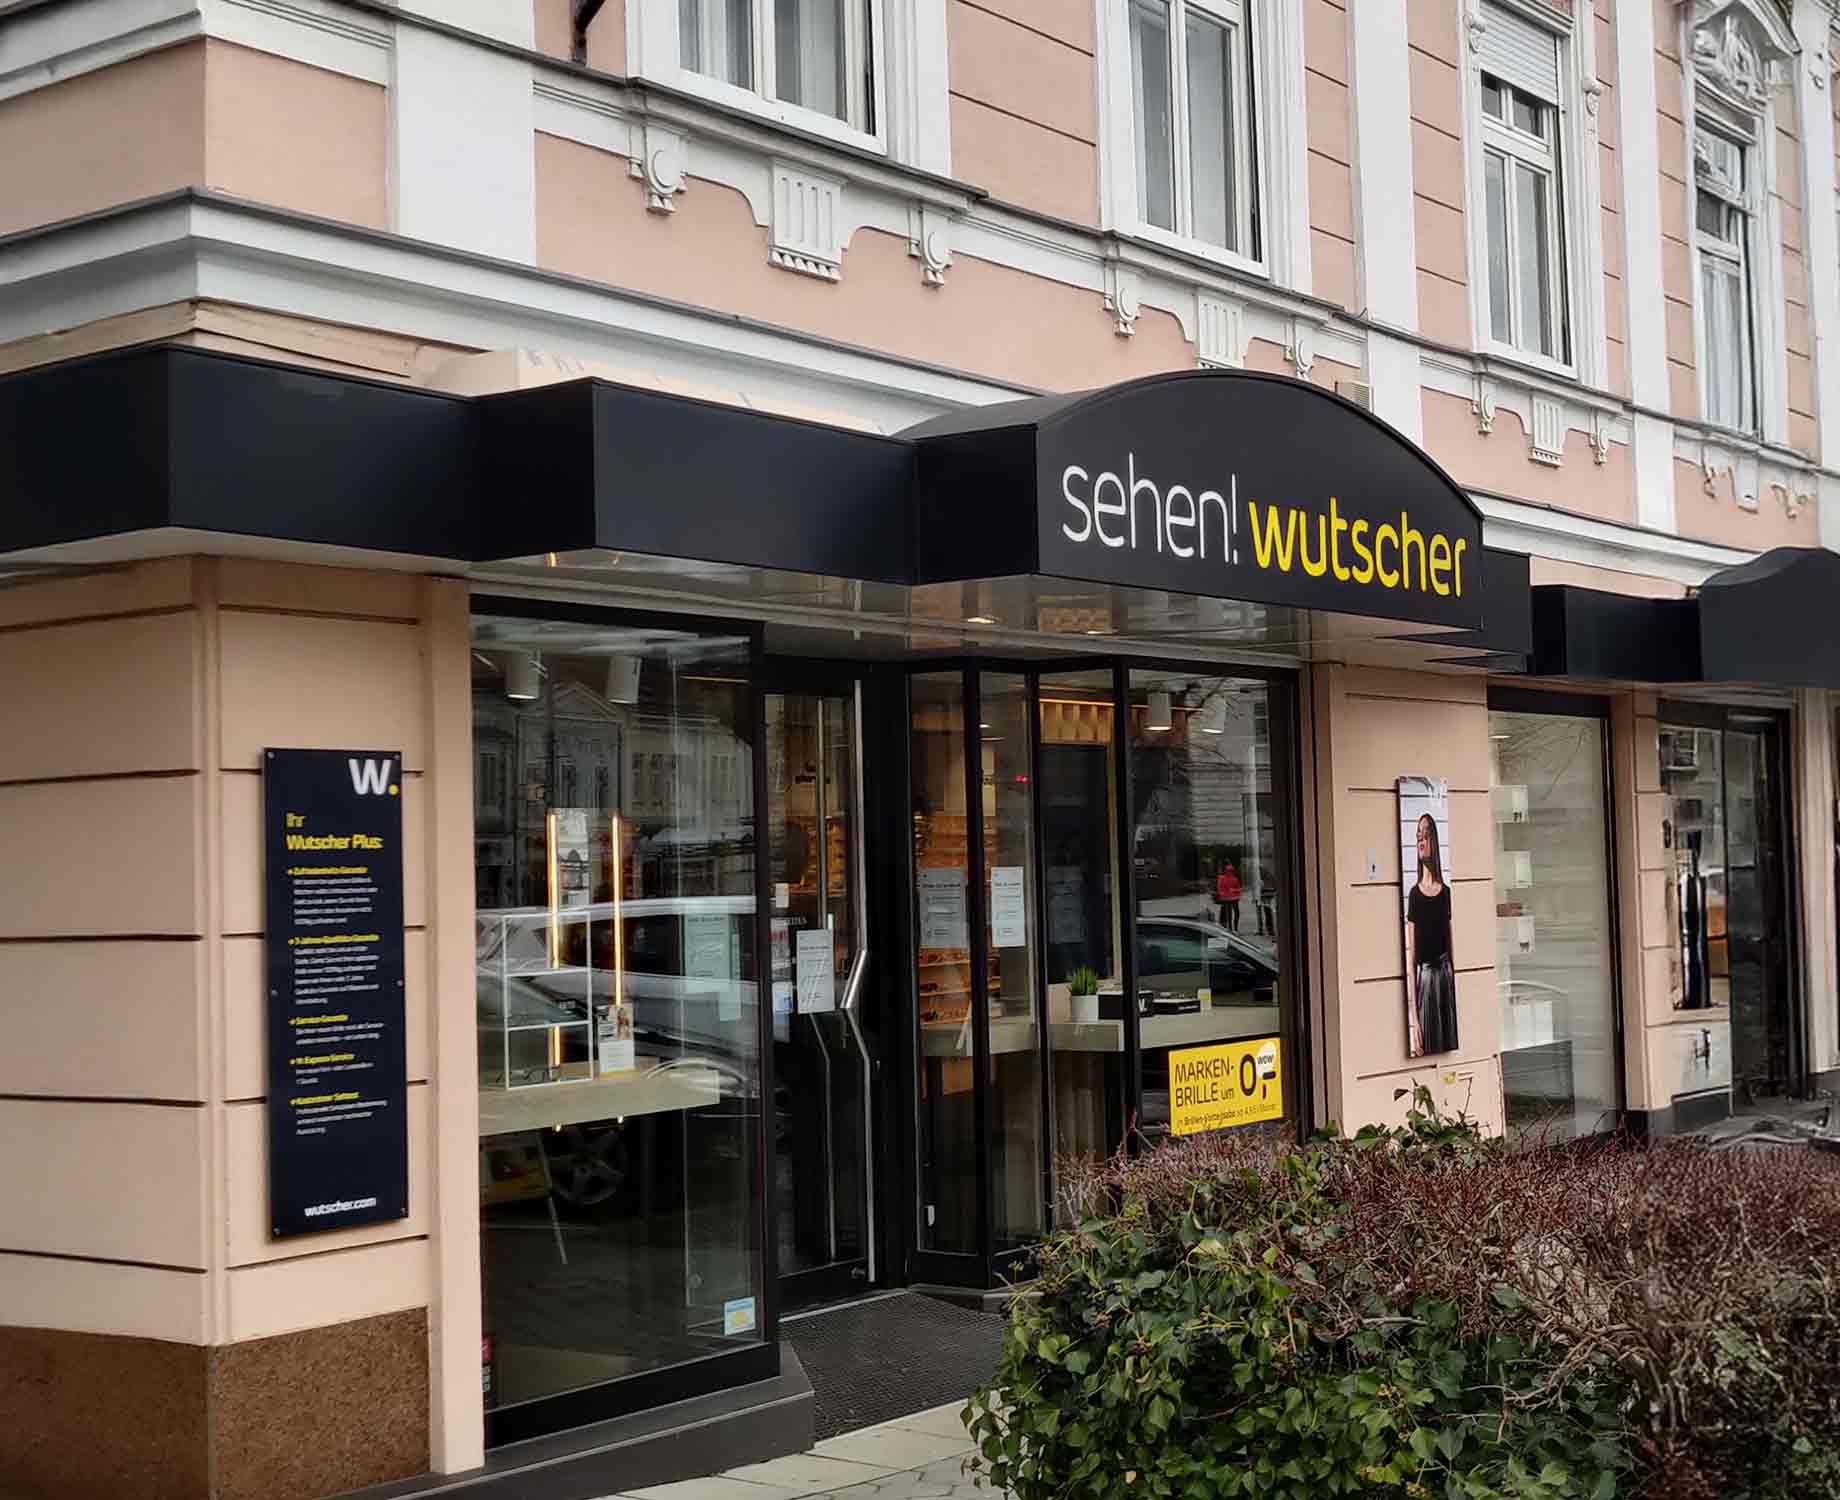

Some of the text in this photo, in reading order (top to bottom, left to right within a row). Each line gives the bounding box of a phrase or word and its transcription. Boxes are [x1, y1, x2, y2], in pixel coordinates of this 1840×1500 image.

[1062, 452, 1467, 598] sehen! wutscher
[348, 758, 400, 796] W.
[286, 834, 351, 850] Wutscher
[1175, 1055, 1235, 1085] MARKEN-
[1175, 1082, 1218, 1108] BRILLE
[304, 1197, 377, 1217] wutscher.com
